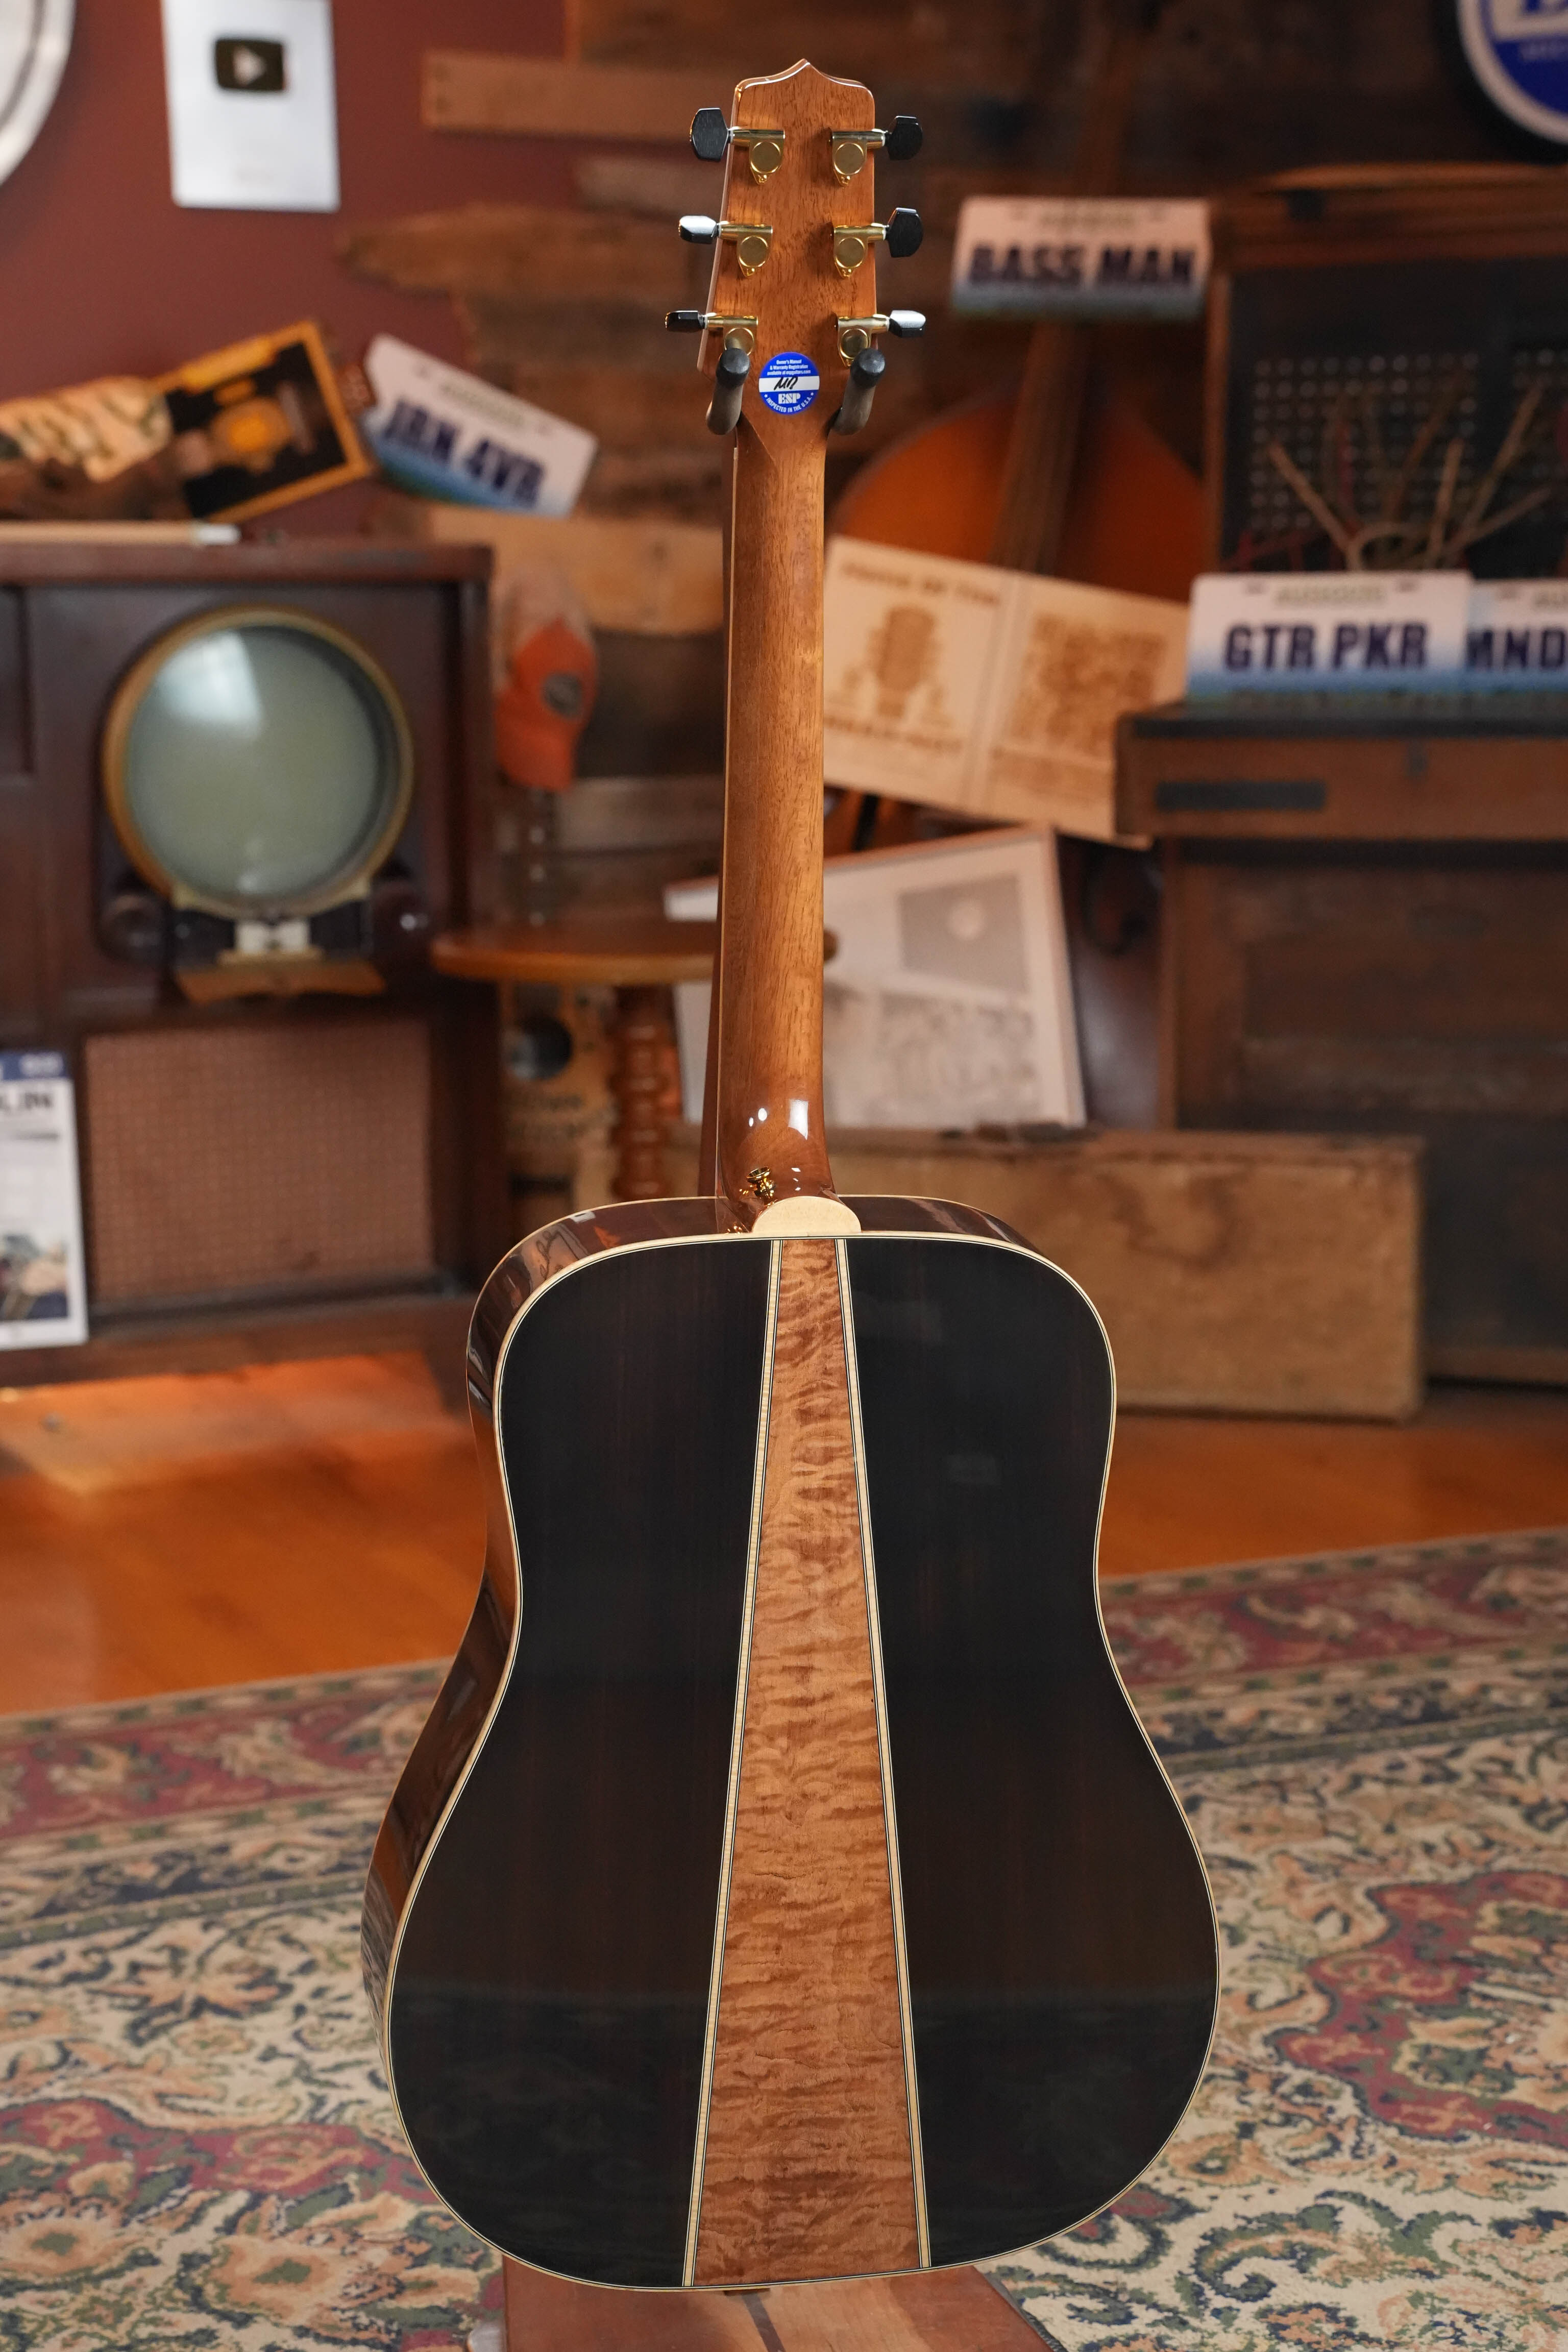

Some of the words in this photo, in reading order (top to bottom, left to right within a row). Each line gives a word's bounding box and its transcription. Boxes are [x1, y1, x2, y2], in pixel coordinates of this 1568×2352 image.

[967, 242, 1083, 284] BASS
[1095, 244, 1196, 285] MAN
[766, 397, 787, 413] INSPECTED
[778, 393, 801, 404] ESP
[1223, 623, 1316, 671] GTR
[1331, 622, 1428, 671] PKR
